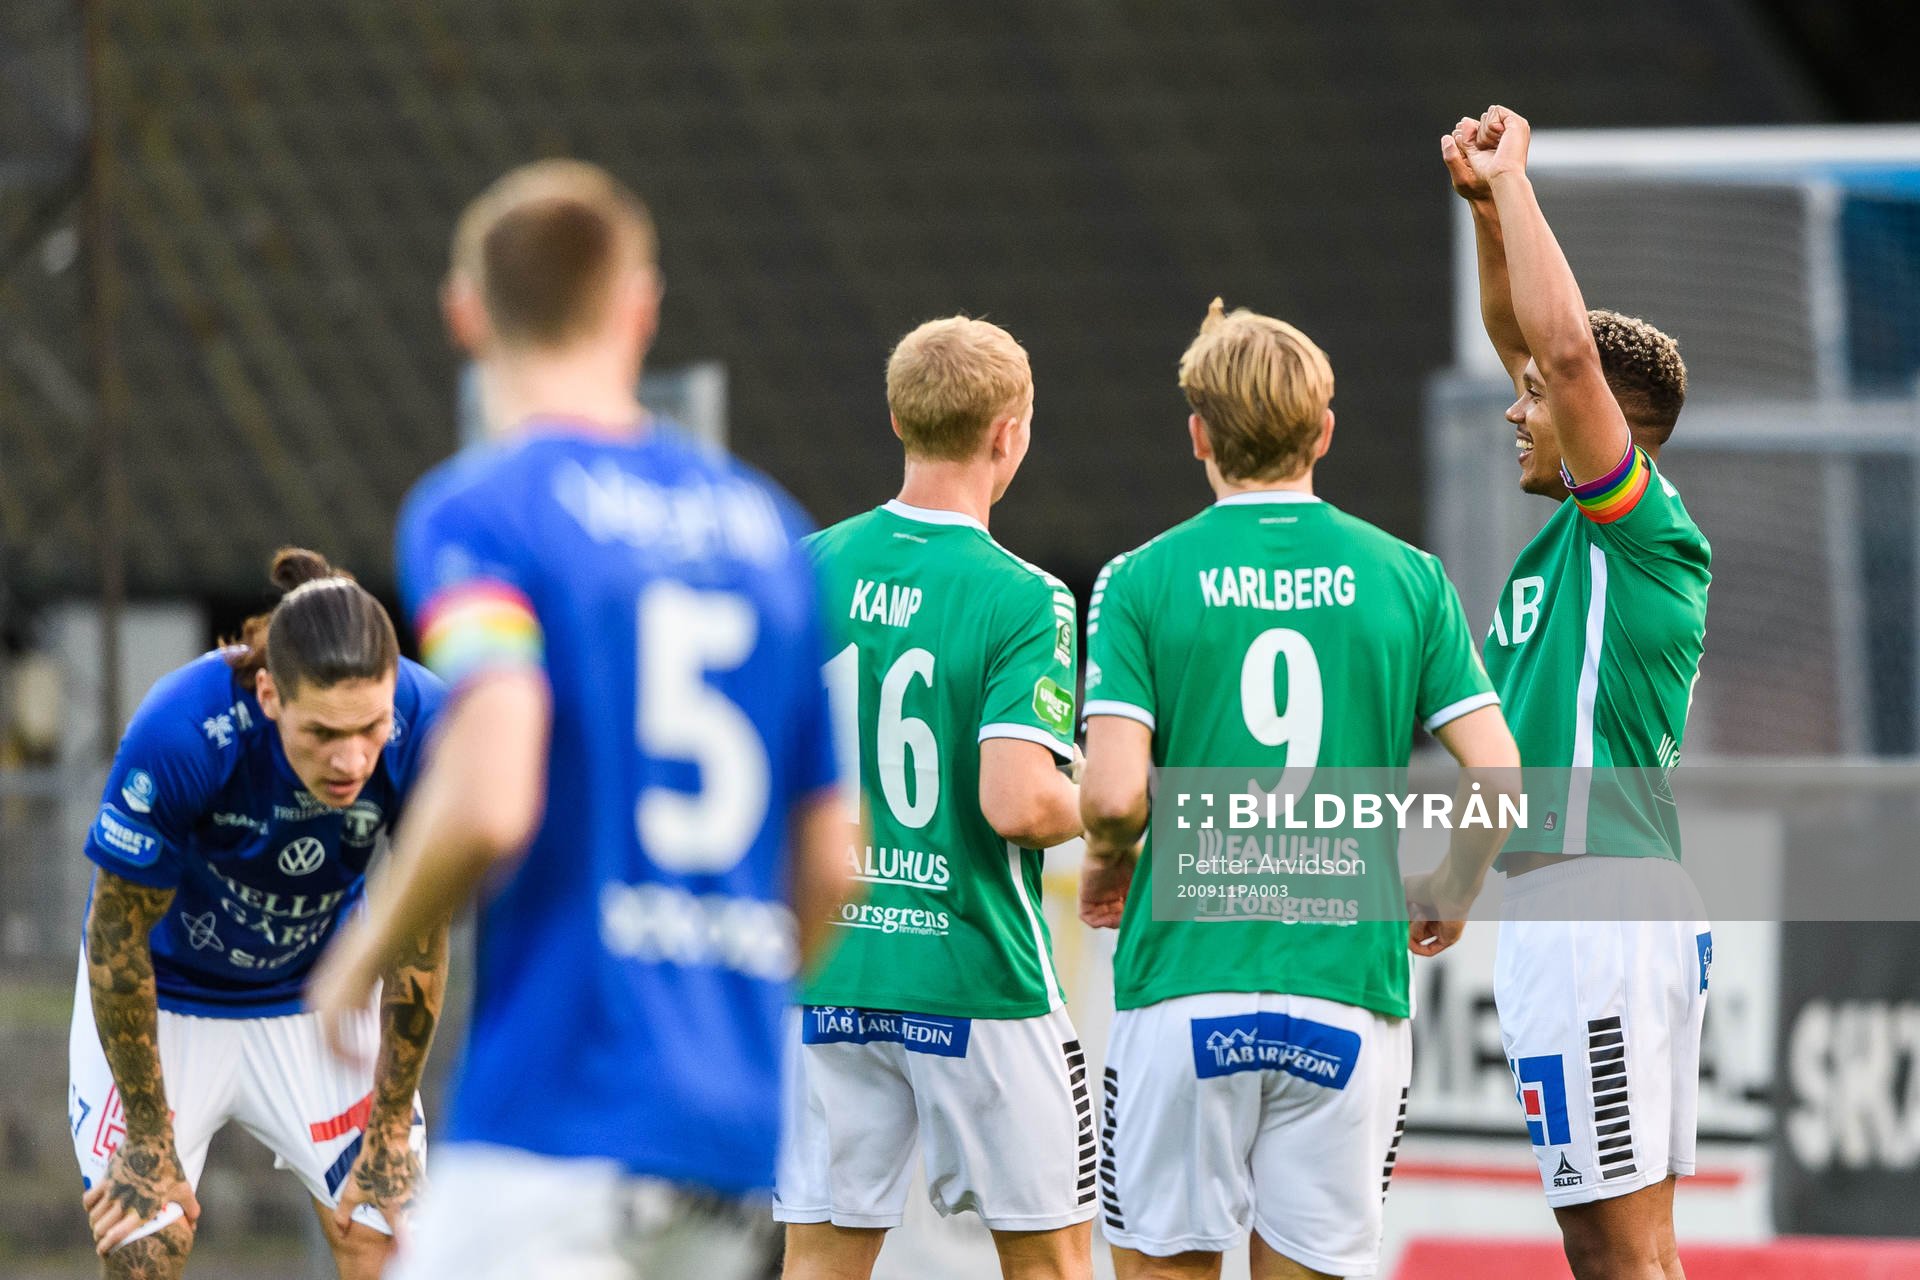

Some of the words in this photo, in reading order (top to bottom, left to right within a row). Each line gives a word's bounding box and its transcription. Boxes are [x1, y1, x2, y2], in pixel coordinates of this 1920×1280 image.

[849, 578, 923, 628] KAMP
[1199, 565, 1356, 611] KARLBERG
[635, 580, 772, 875] 5
[820, 641, 940, 829] 16
[1240, 627, 1324, 818] 9
[101, 811, 156, 851] UNIBET
[845, 845, 951, 885] ALUHUS
[836, 902, 950, 934] orsgrens
[1553, 1175, 1583, 1188] SELECT
